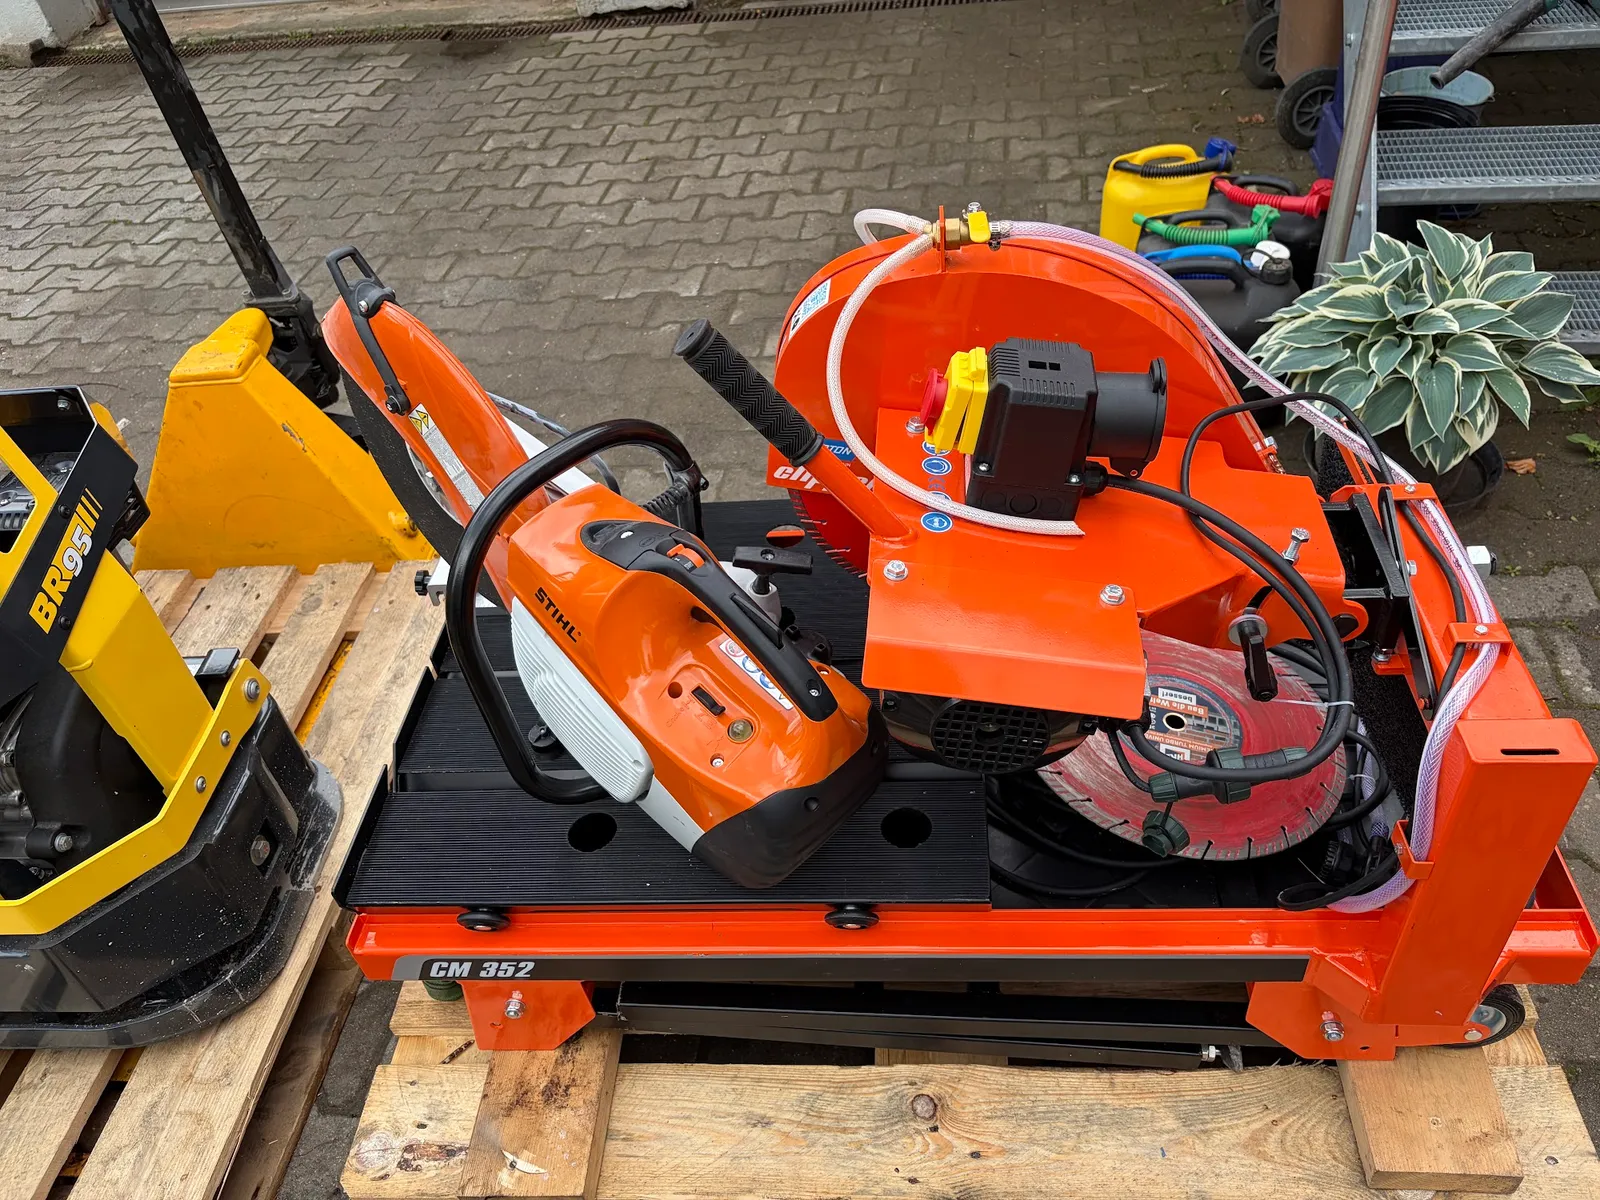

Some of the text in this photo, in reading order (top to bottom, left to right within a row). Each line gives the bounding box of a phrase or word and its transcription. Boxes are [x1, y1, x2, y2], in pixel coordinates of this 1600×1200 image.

[28, 524, 93, 634] BR95
[534, 586, 578, 643] STIHL
[1161, 690, 1193, 702] besser!
[1172, 701, 1185, 711] die
[1187, 705, 1204, 715] Bau
[1144, 732, 1164, 742] UNIVE
[1165, 738, 1187, 747] TURBO
[1188, 743, 1214, 753] EMIUM
[429, 961, 536, 978] CM 352
